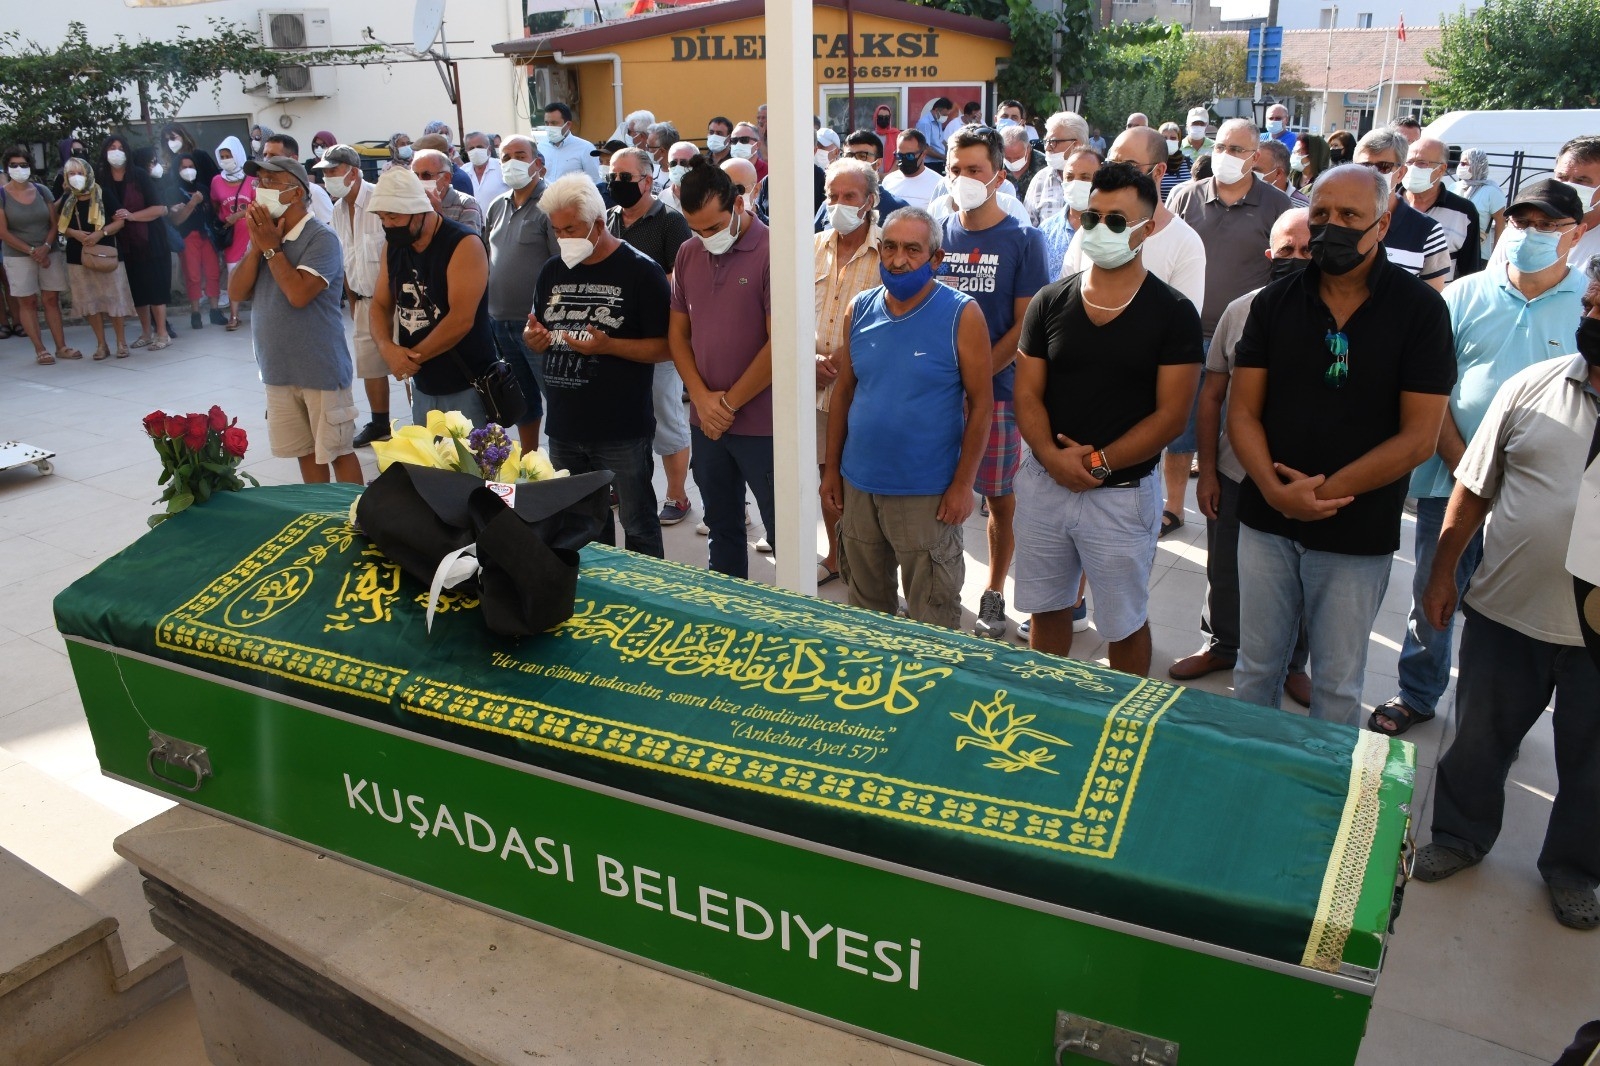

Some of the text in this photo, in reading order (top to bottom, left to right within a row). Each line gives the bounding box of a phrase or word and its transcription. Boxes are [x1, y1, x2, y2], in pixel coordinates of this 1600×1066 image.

[871, 66, 901, 78] 657
[904, 66, 918, 77] 11
[922, 65, 938, 77] 10
[951, 264, 996, 275] TALLINN
[959, 276, 996, 293] 2019
[566, 305, 591, 320] and
[518, 661, 542, 675] can
[544, 664, 591, 684] ölümü
[589, 674, 663, 701] tadacaktır,
[665, 692, 708, 708] sonra
[708, 695, 742, 714] bize
[741, 703, 897, 742] döndürüleceksiniz.”
[730, 719, 889, 764] “(Ankebut Ayet 57)”
[343, 773, 575, 882] KUŞADASI
